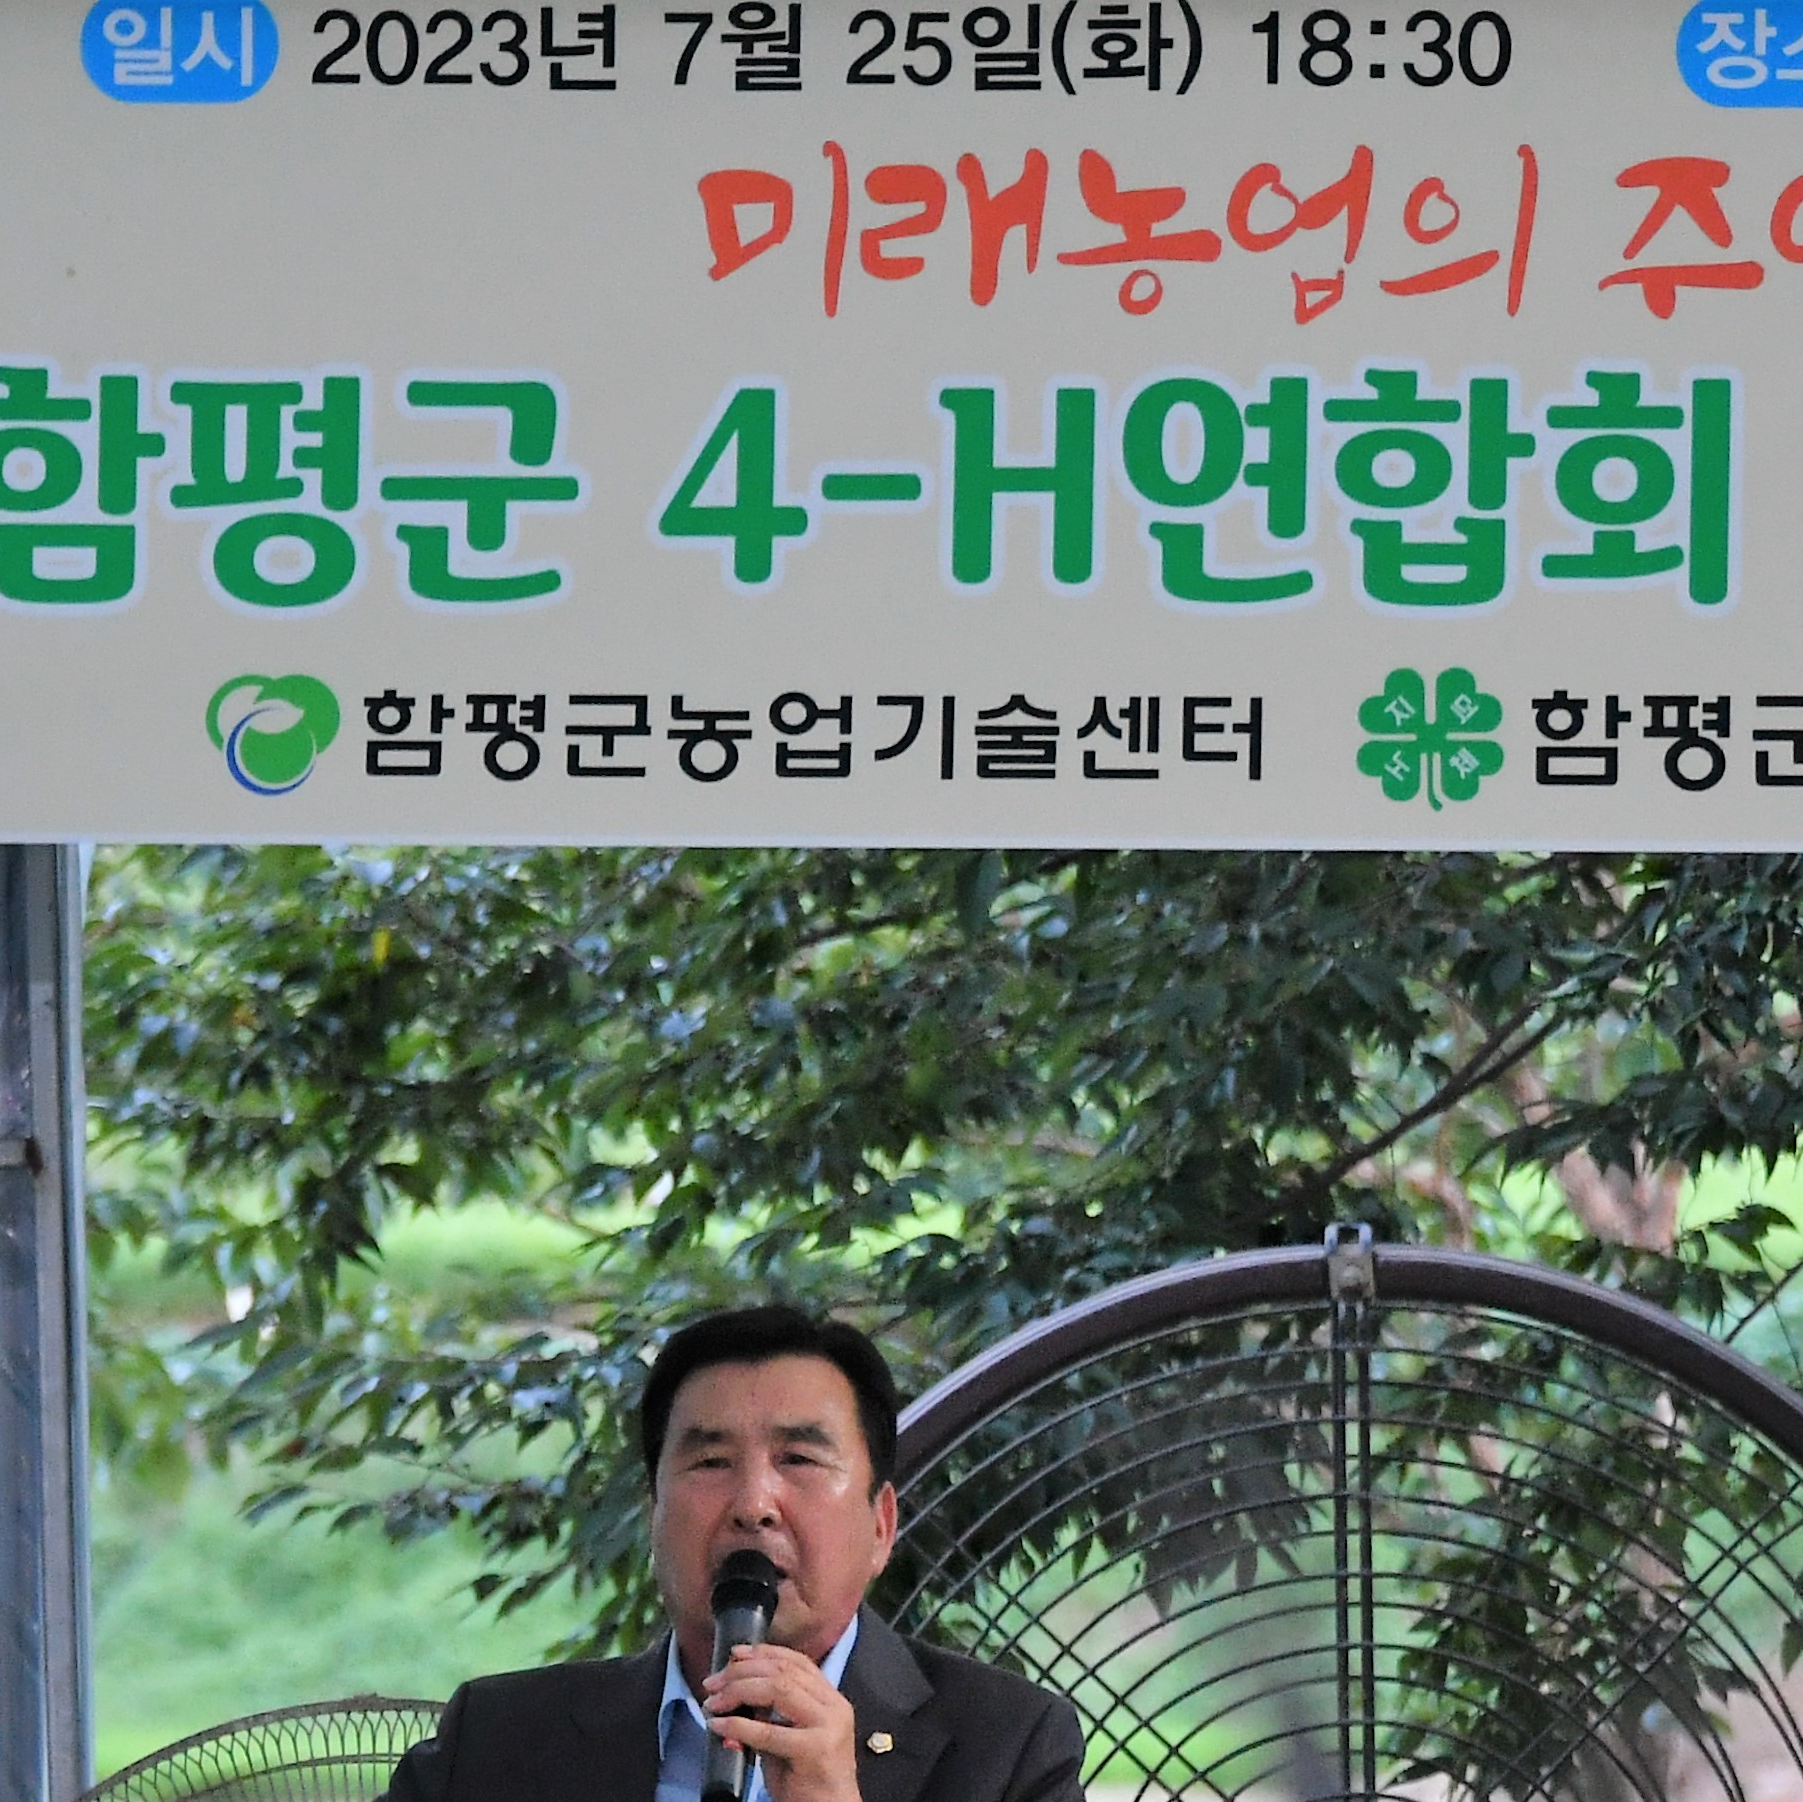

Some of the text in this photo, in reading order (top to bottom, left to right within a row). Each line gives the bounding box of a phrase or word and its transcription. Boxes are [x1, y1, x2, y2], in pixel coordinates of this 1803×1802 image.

[102, 0, 1513, 96] 일시 2023년 7월 25일(화) 18:30
[697, 141, 1539, 326] 미래농업의
[658, 367, 1732, 608] 4-H연합회
[362, 688, 1265, 783] 함평군농업기술센터
